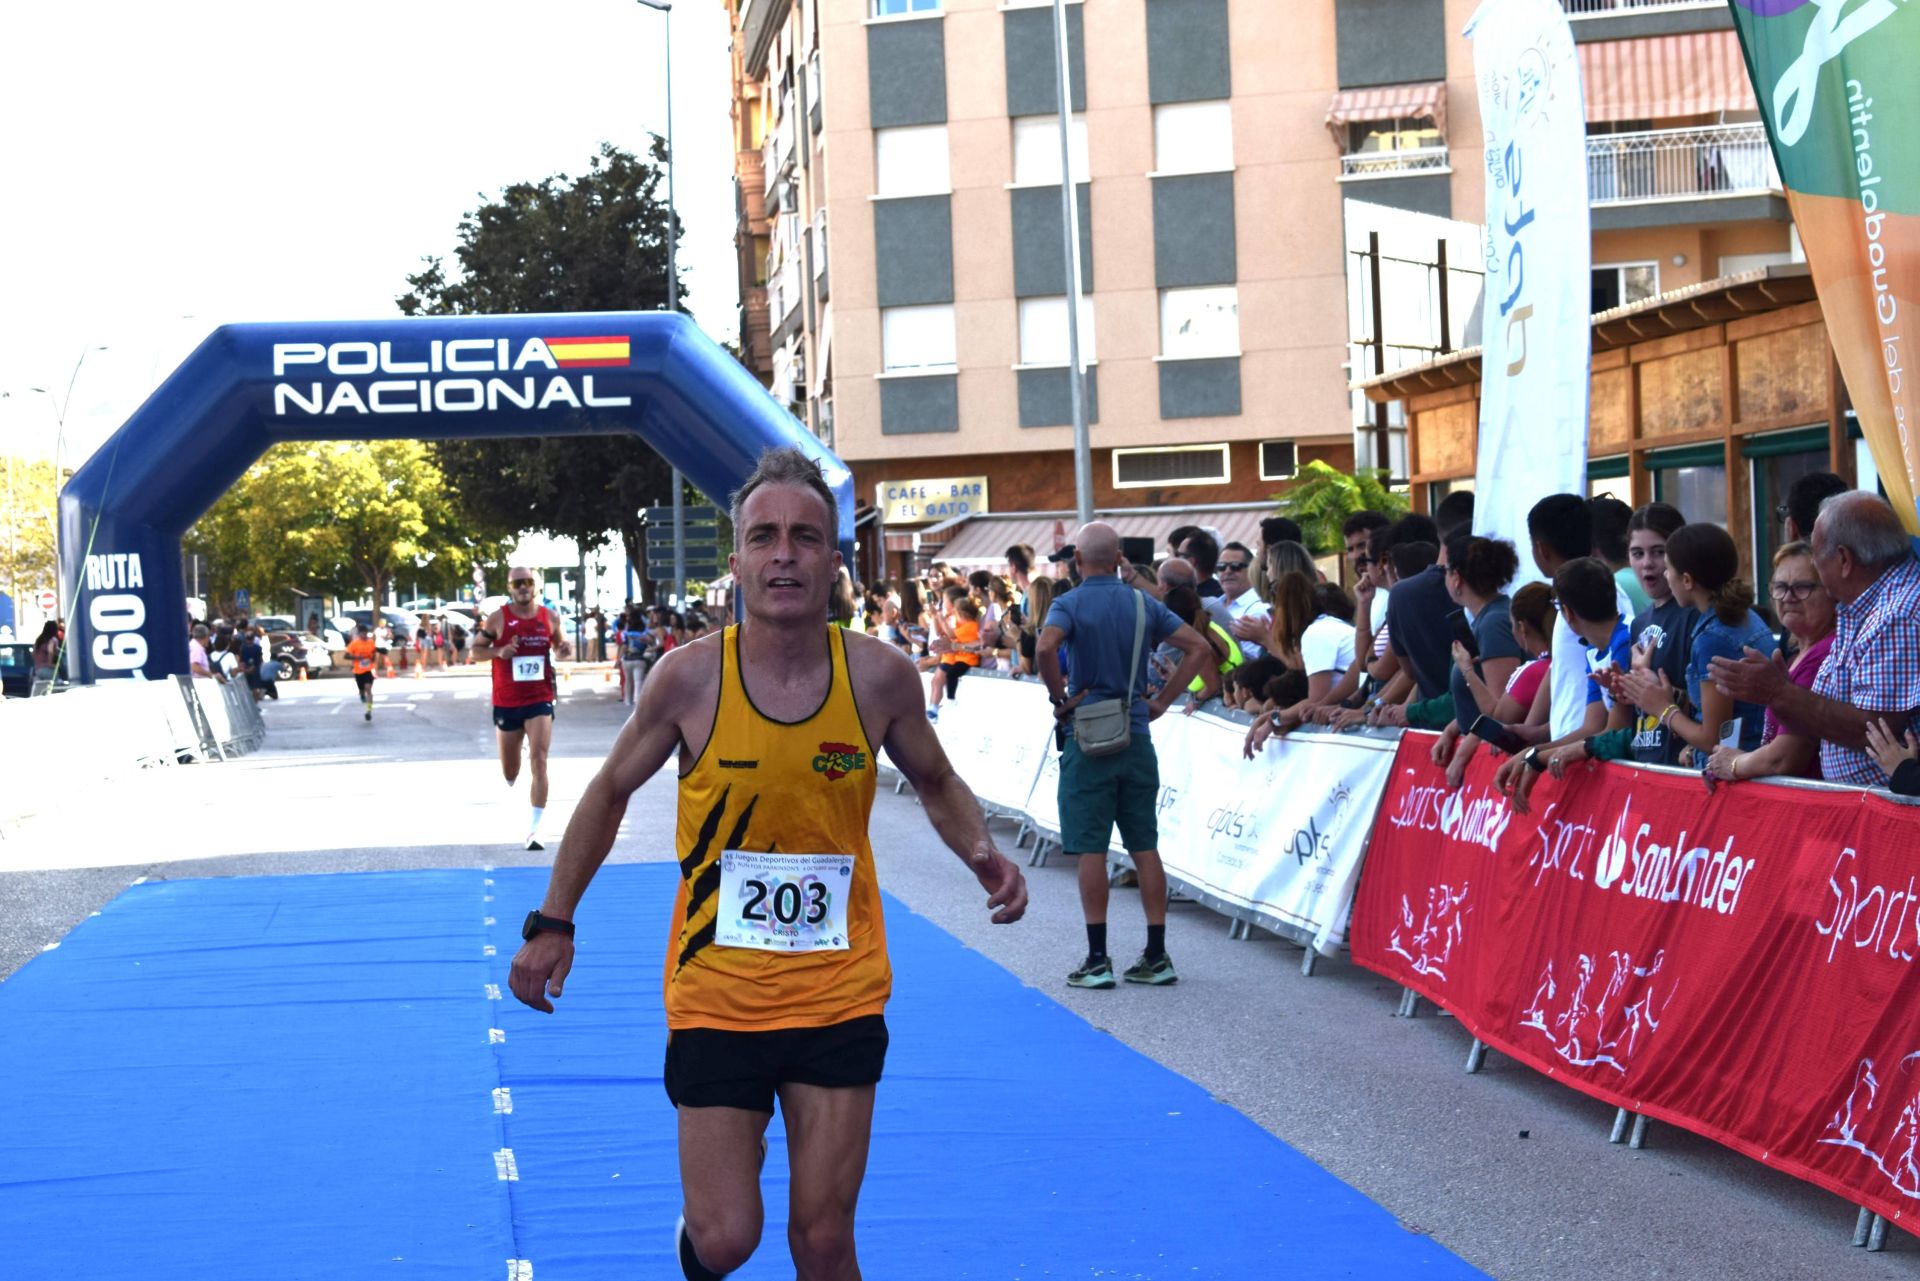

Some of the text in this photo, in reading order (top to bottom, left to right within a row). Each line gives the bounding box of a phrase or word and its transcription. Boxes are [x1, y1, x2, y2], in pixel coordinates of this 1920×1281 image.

[273, 336, 559, 376] POLICIA
[273, 375, 632, 415] NACIONAL
[950, 483, 982, 498] BAR
[902, 501, 970, 516] EL GATO
[86, 552, 144, 590] RUTA
[518, 663, 540, 674] 179
[742, 879, 828, 925] 203
[772, 928, 799, 937] CRISTO
